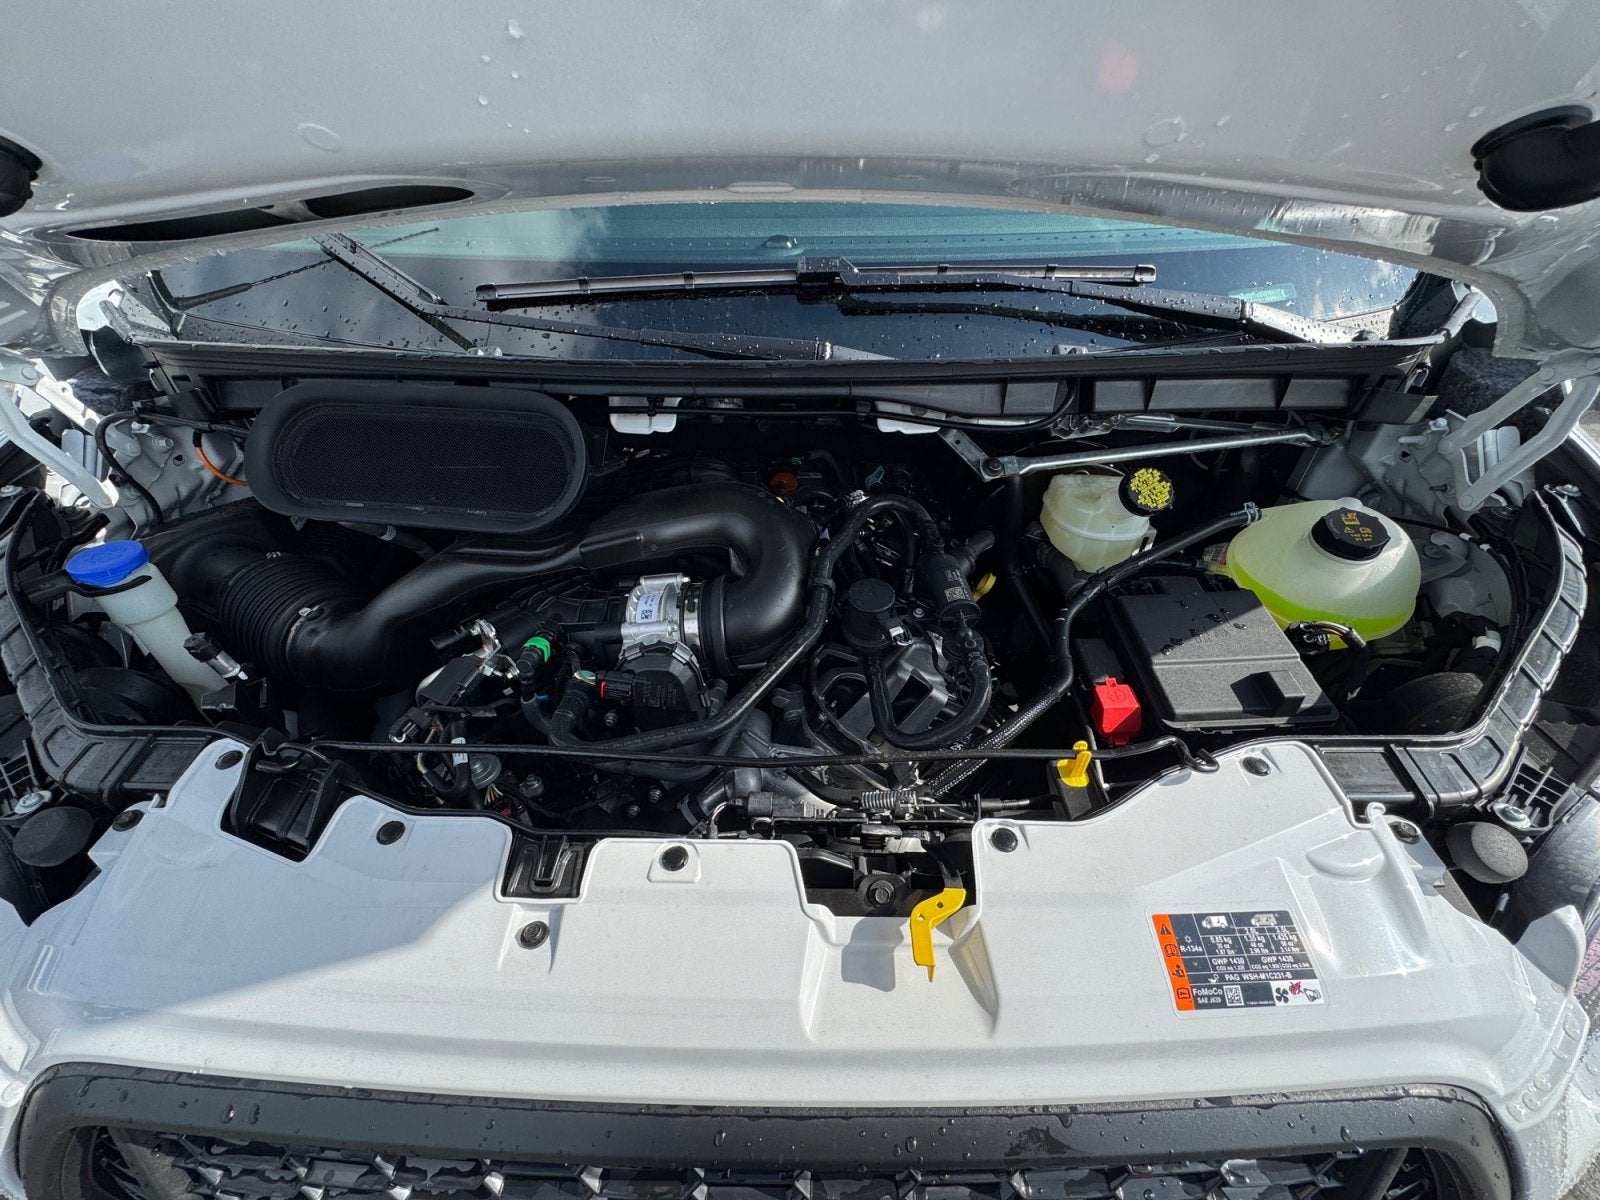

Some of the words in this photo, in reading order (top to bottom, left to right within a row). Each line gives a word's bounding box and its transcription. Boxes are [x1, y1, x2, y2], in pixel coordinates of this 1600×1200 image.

[1223, 935, 1232, 944] kg
[1257, 934, 1266, 943] kg
[1289, 934, 1298, 942] kg
[1193, 987, 1222, 996] FoMoCo
